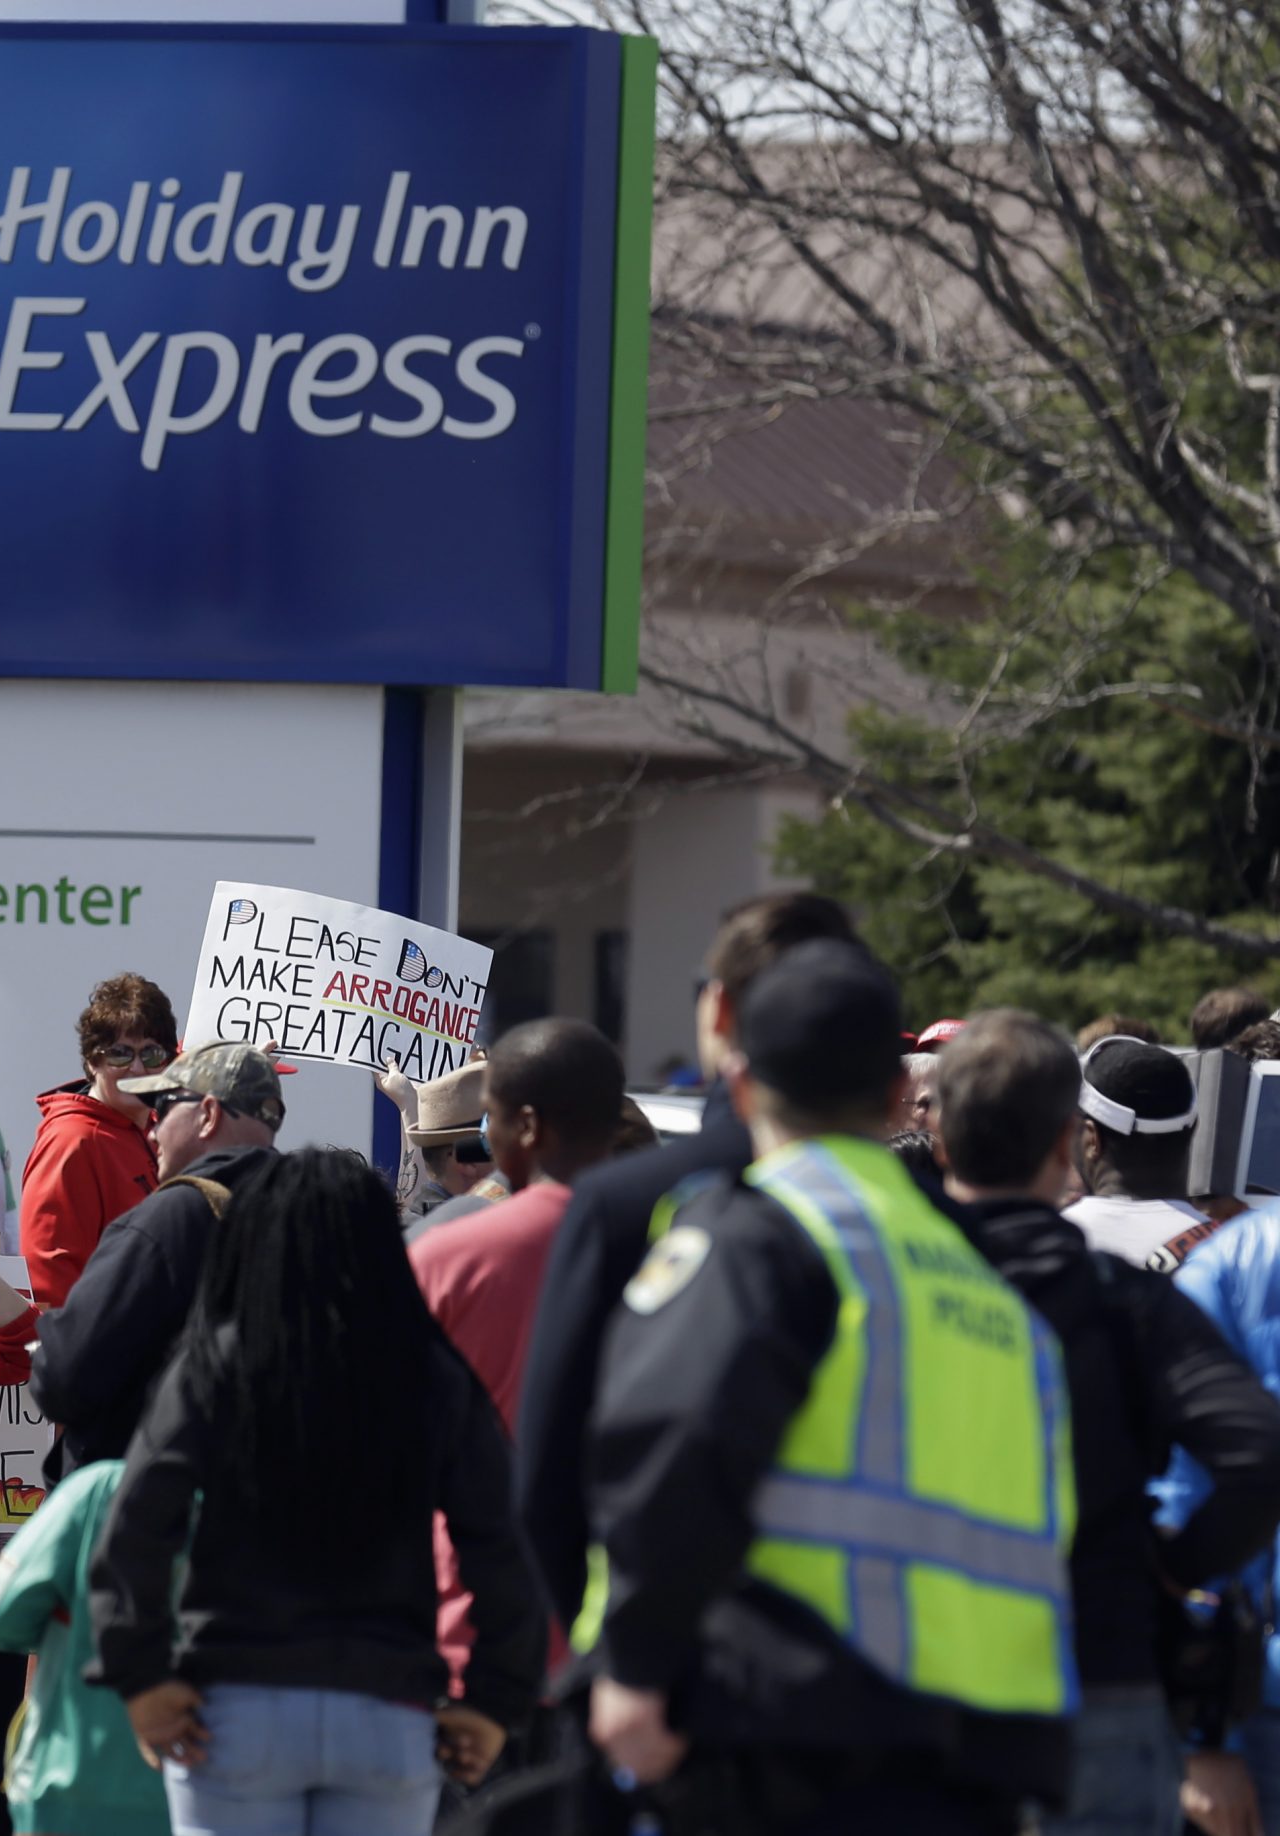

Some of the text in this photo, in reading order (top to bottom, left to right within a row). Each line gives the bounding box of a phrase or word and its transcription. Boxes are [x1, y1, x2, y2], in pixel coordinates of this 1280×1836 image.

[372, 171, 529, 270] Inn
[223, 899, 381, 967] PLEASE
[209, 955, 481, 1044] MAKE ARROGANCE
